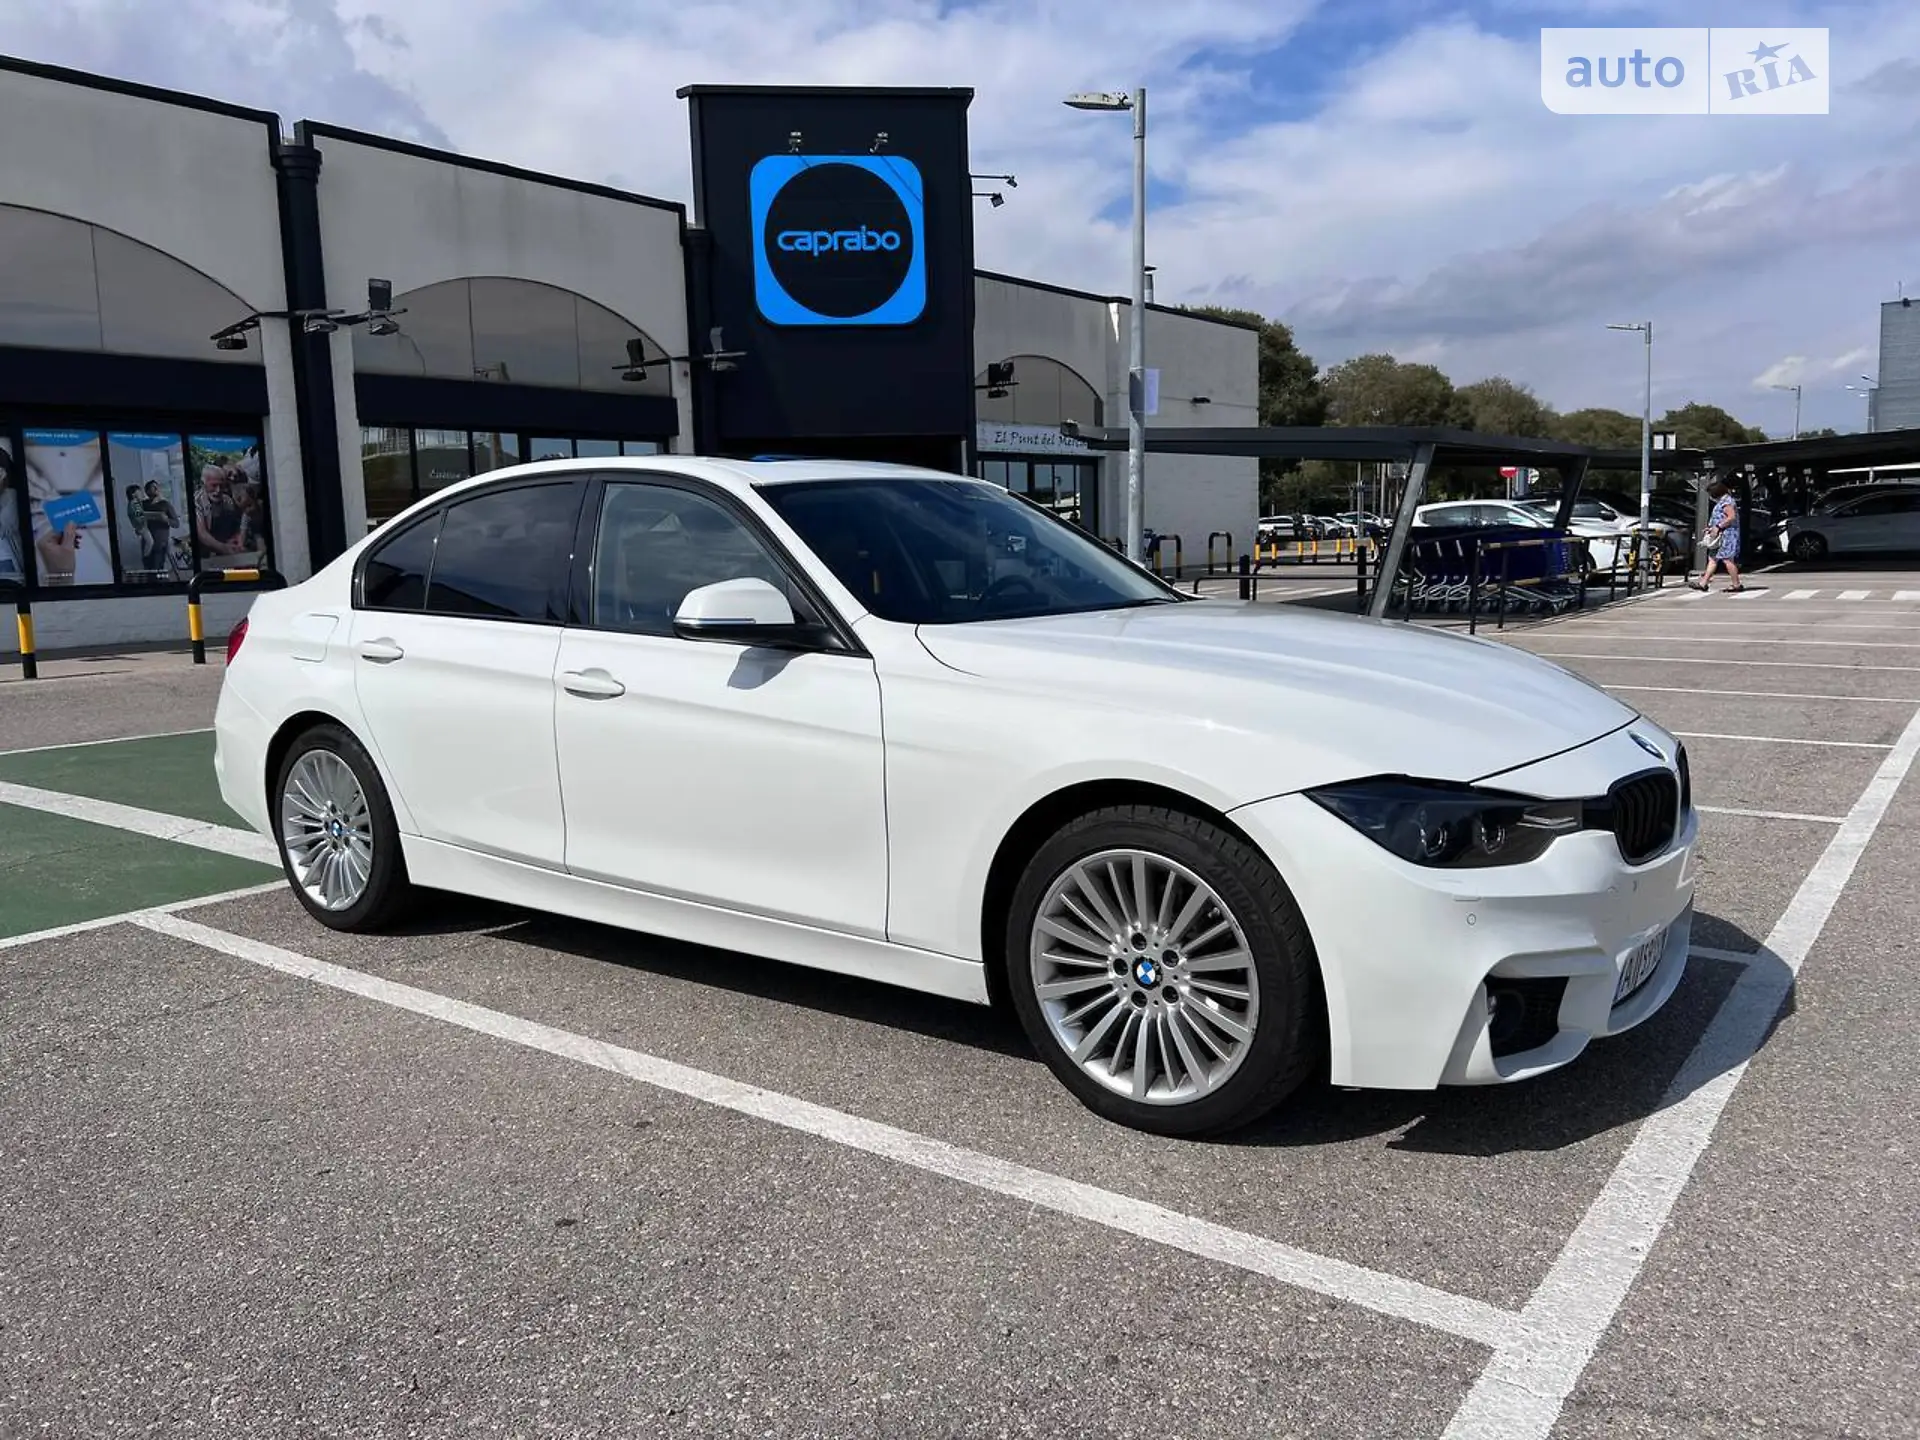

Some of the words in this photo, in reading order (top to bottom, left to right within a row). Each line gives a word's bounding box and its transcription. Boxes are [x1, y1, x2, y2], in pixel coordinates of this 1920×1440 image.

[777, 225, 900, 257] caprabo
[994, 431, 1006, 444] El
[1009, 431, 1039, 446] Punt
[1041, 432, 1056, 446] del
